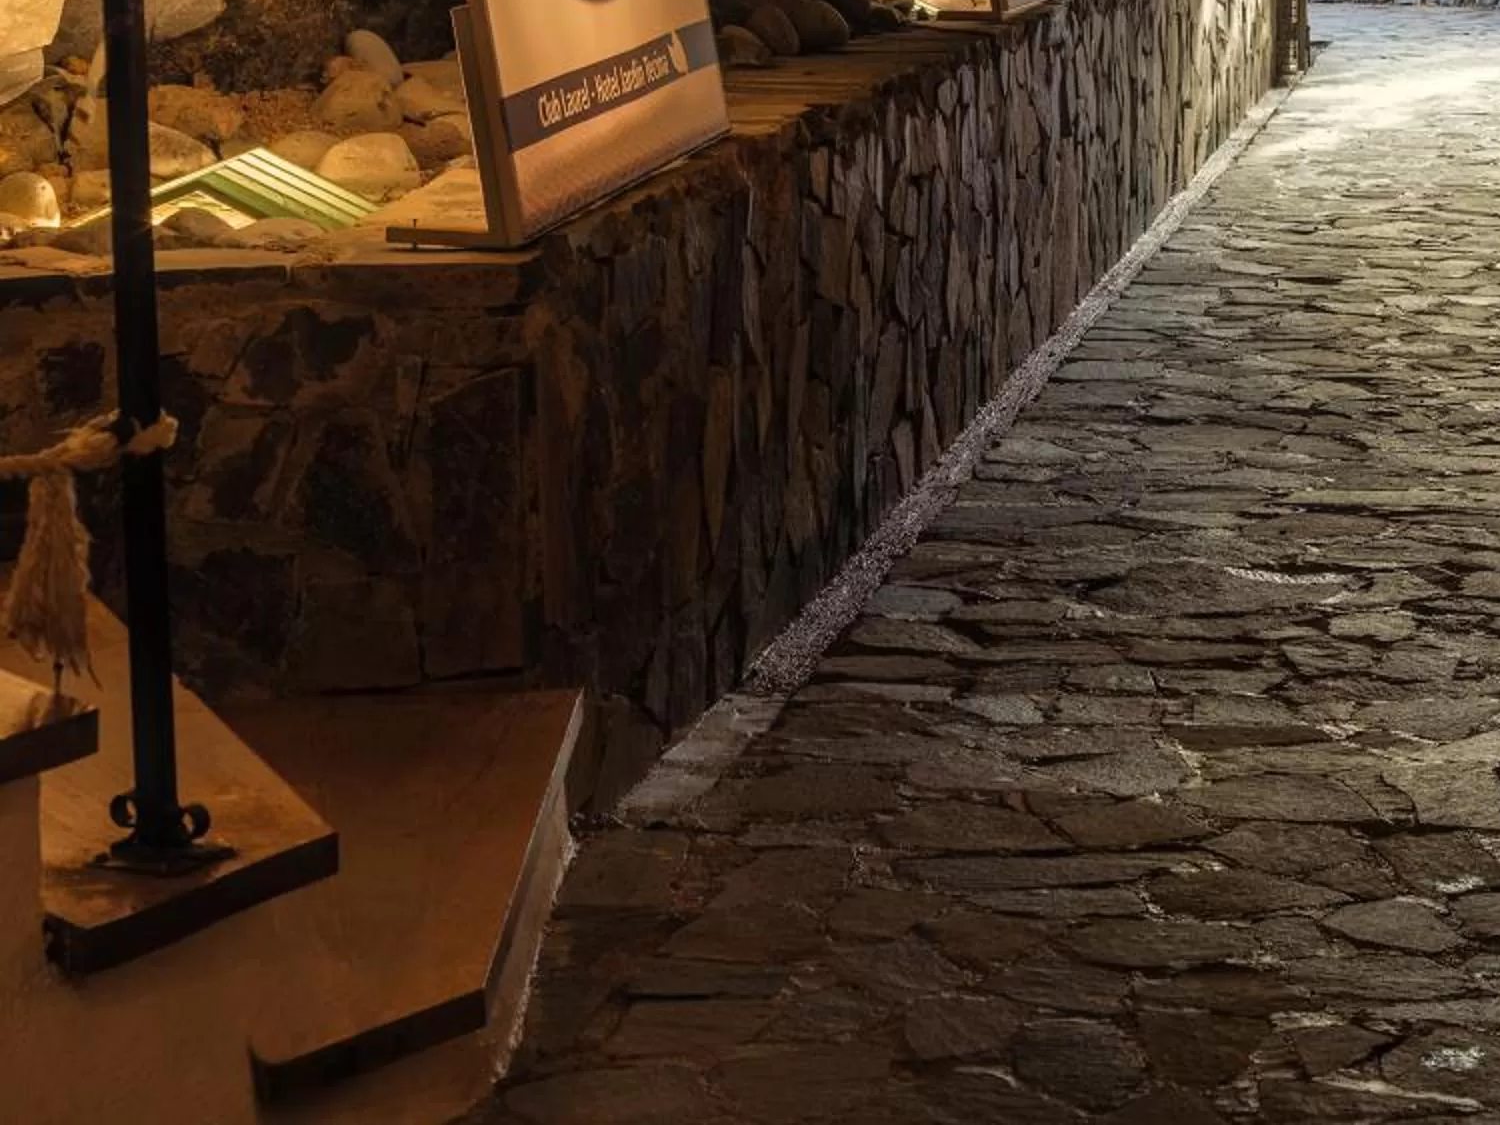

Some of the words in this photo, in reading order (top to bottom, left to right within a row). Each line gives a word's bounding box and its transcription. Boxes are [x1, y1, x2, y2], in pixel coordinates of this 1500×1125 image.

[538, 88, 562, 128] Club
[560, 79, 592, 118] Laurel
[596, 67, 620, 102] Hotel
